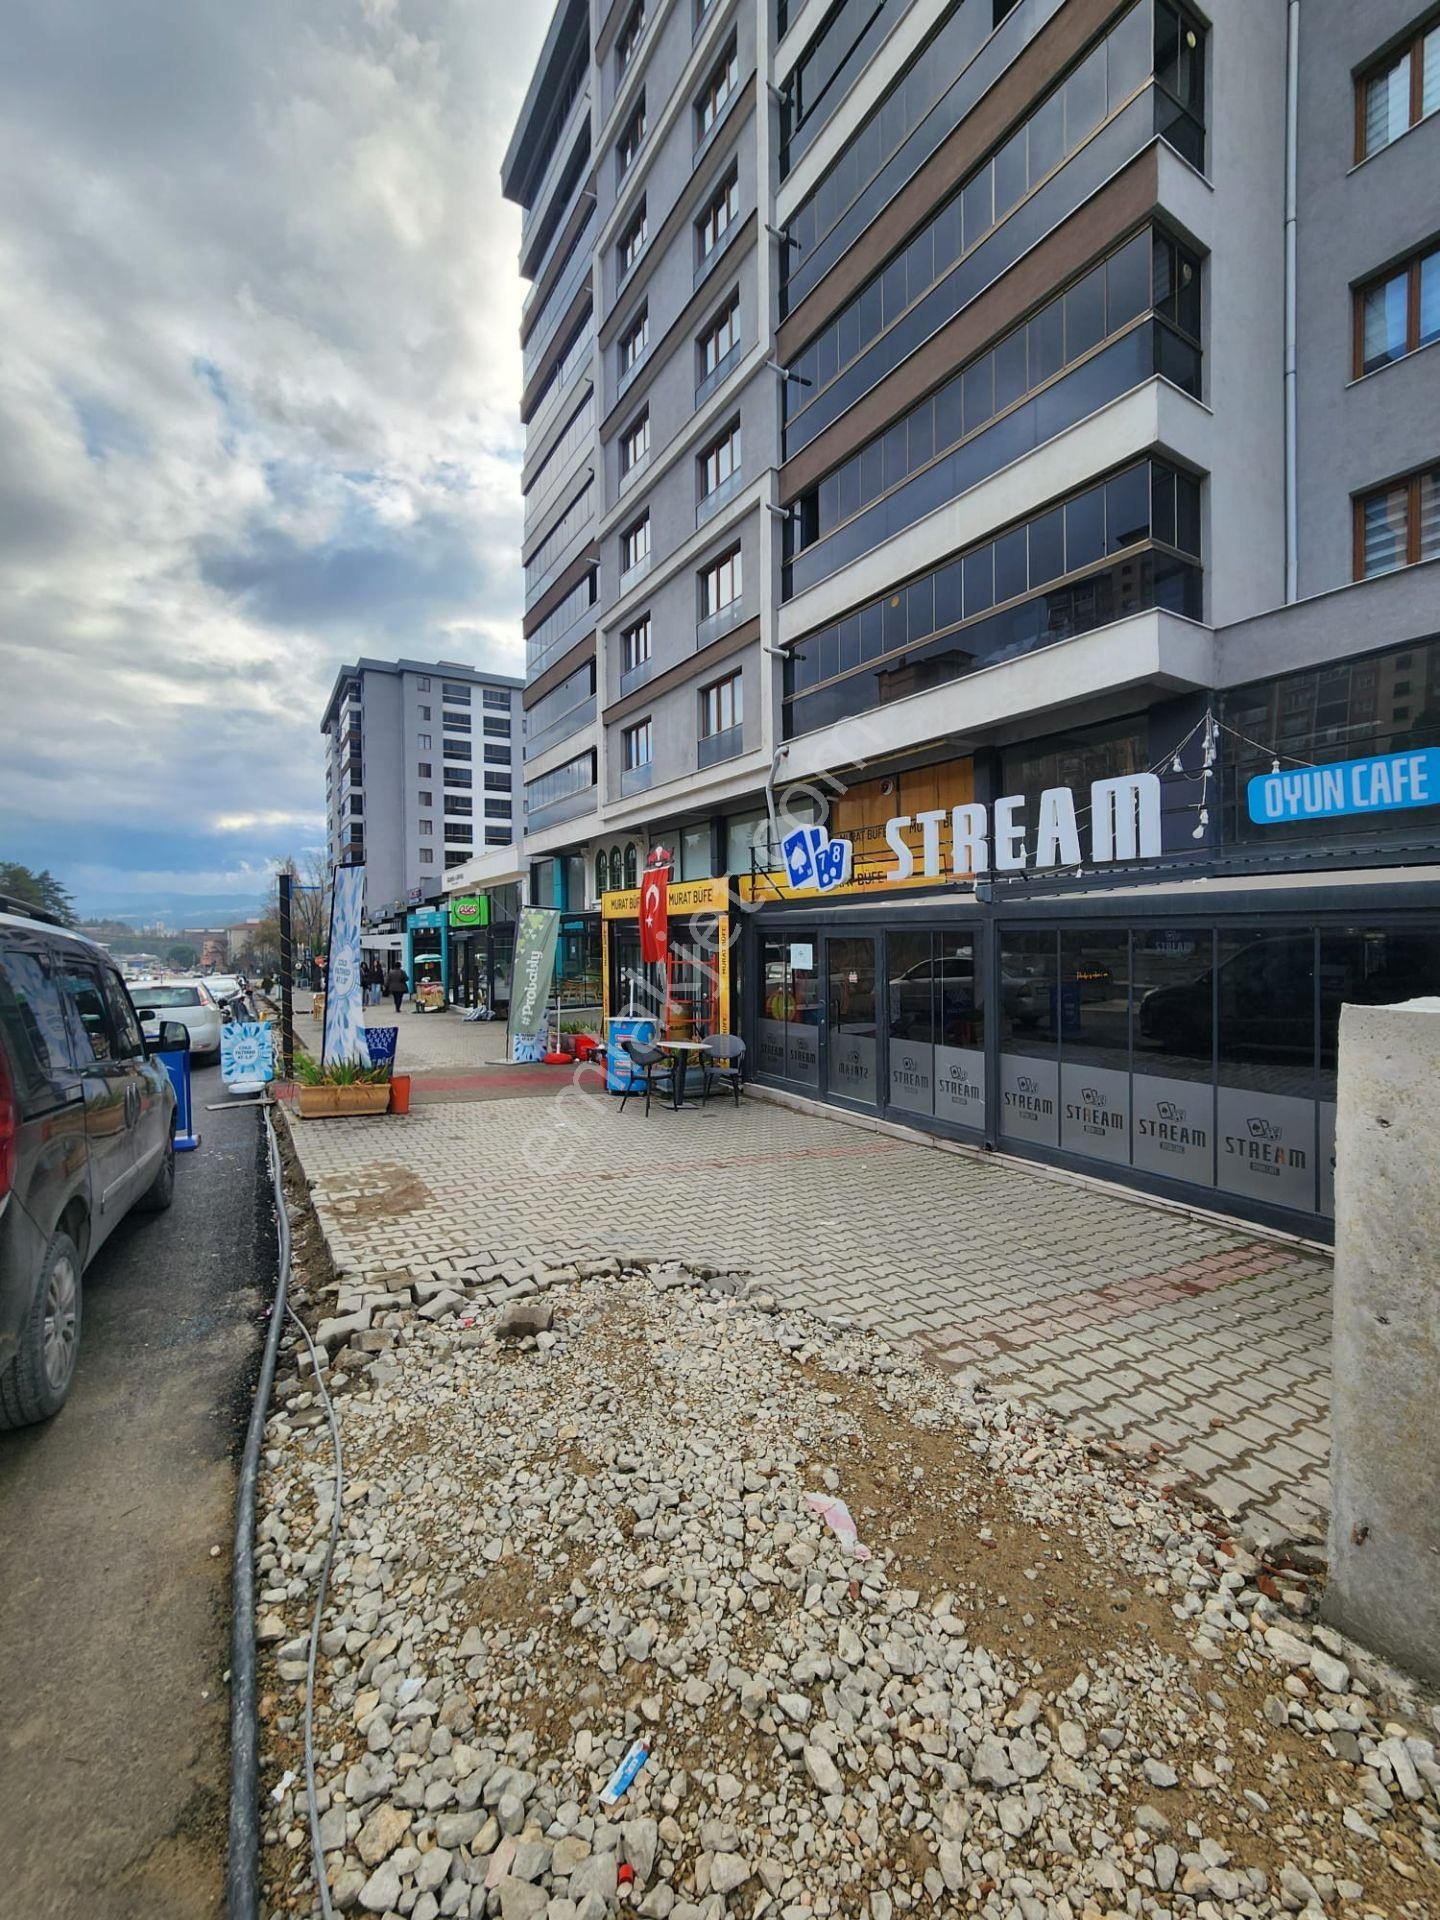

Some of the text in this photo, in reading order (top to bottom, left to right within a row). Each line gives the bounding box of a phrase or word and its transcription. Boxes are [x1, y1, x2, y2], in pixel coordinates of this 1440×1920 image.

[1264, 755, 1429, 818] OYUN CAFE
[886, 772, 1162, 881] STREAM
[818, 853, 826, 870] 7
[832, 845, 841, 863] 8
[611, 894, 640, 910] MURAT BÜF
[669, 886, 713, 907] MURAT BÜFE
[521, 950, 543, 1026] #Probably
[893, 1070, 929, 1089] STREAM
[939, 1079, 979, 1100] STREAM
[1004, 1091, 1053, 1115] STREAM
[1066, 1104, 1124, 1130] STREAM
[1139, 1119, 1207, 1148] STREAM
[1225, 1136, 1306, 1169] STREAM
